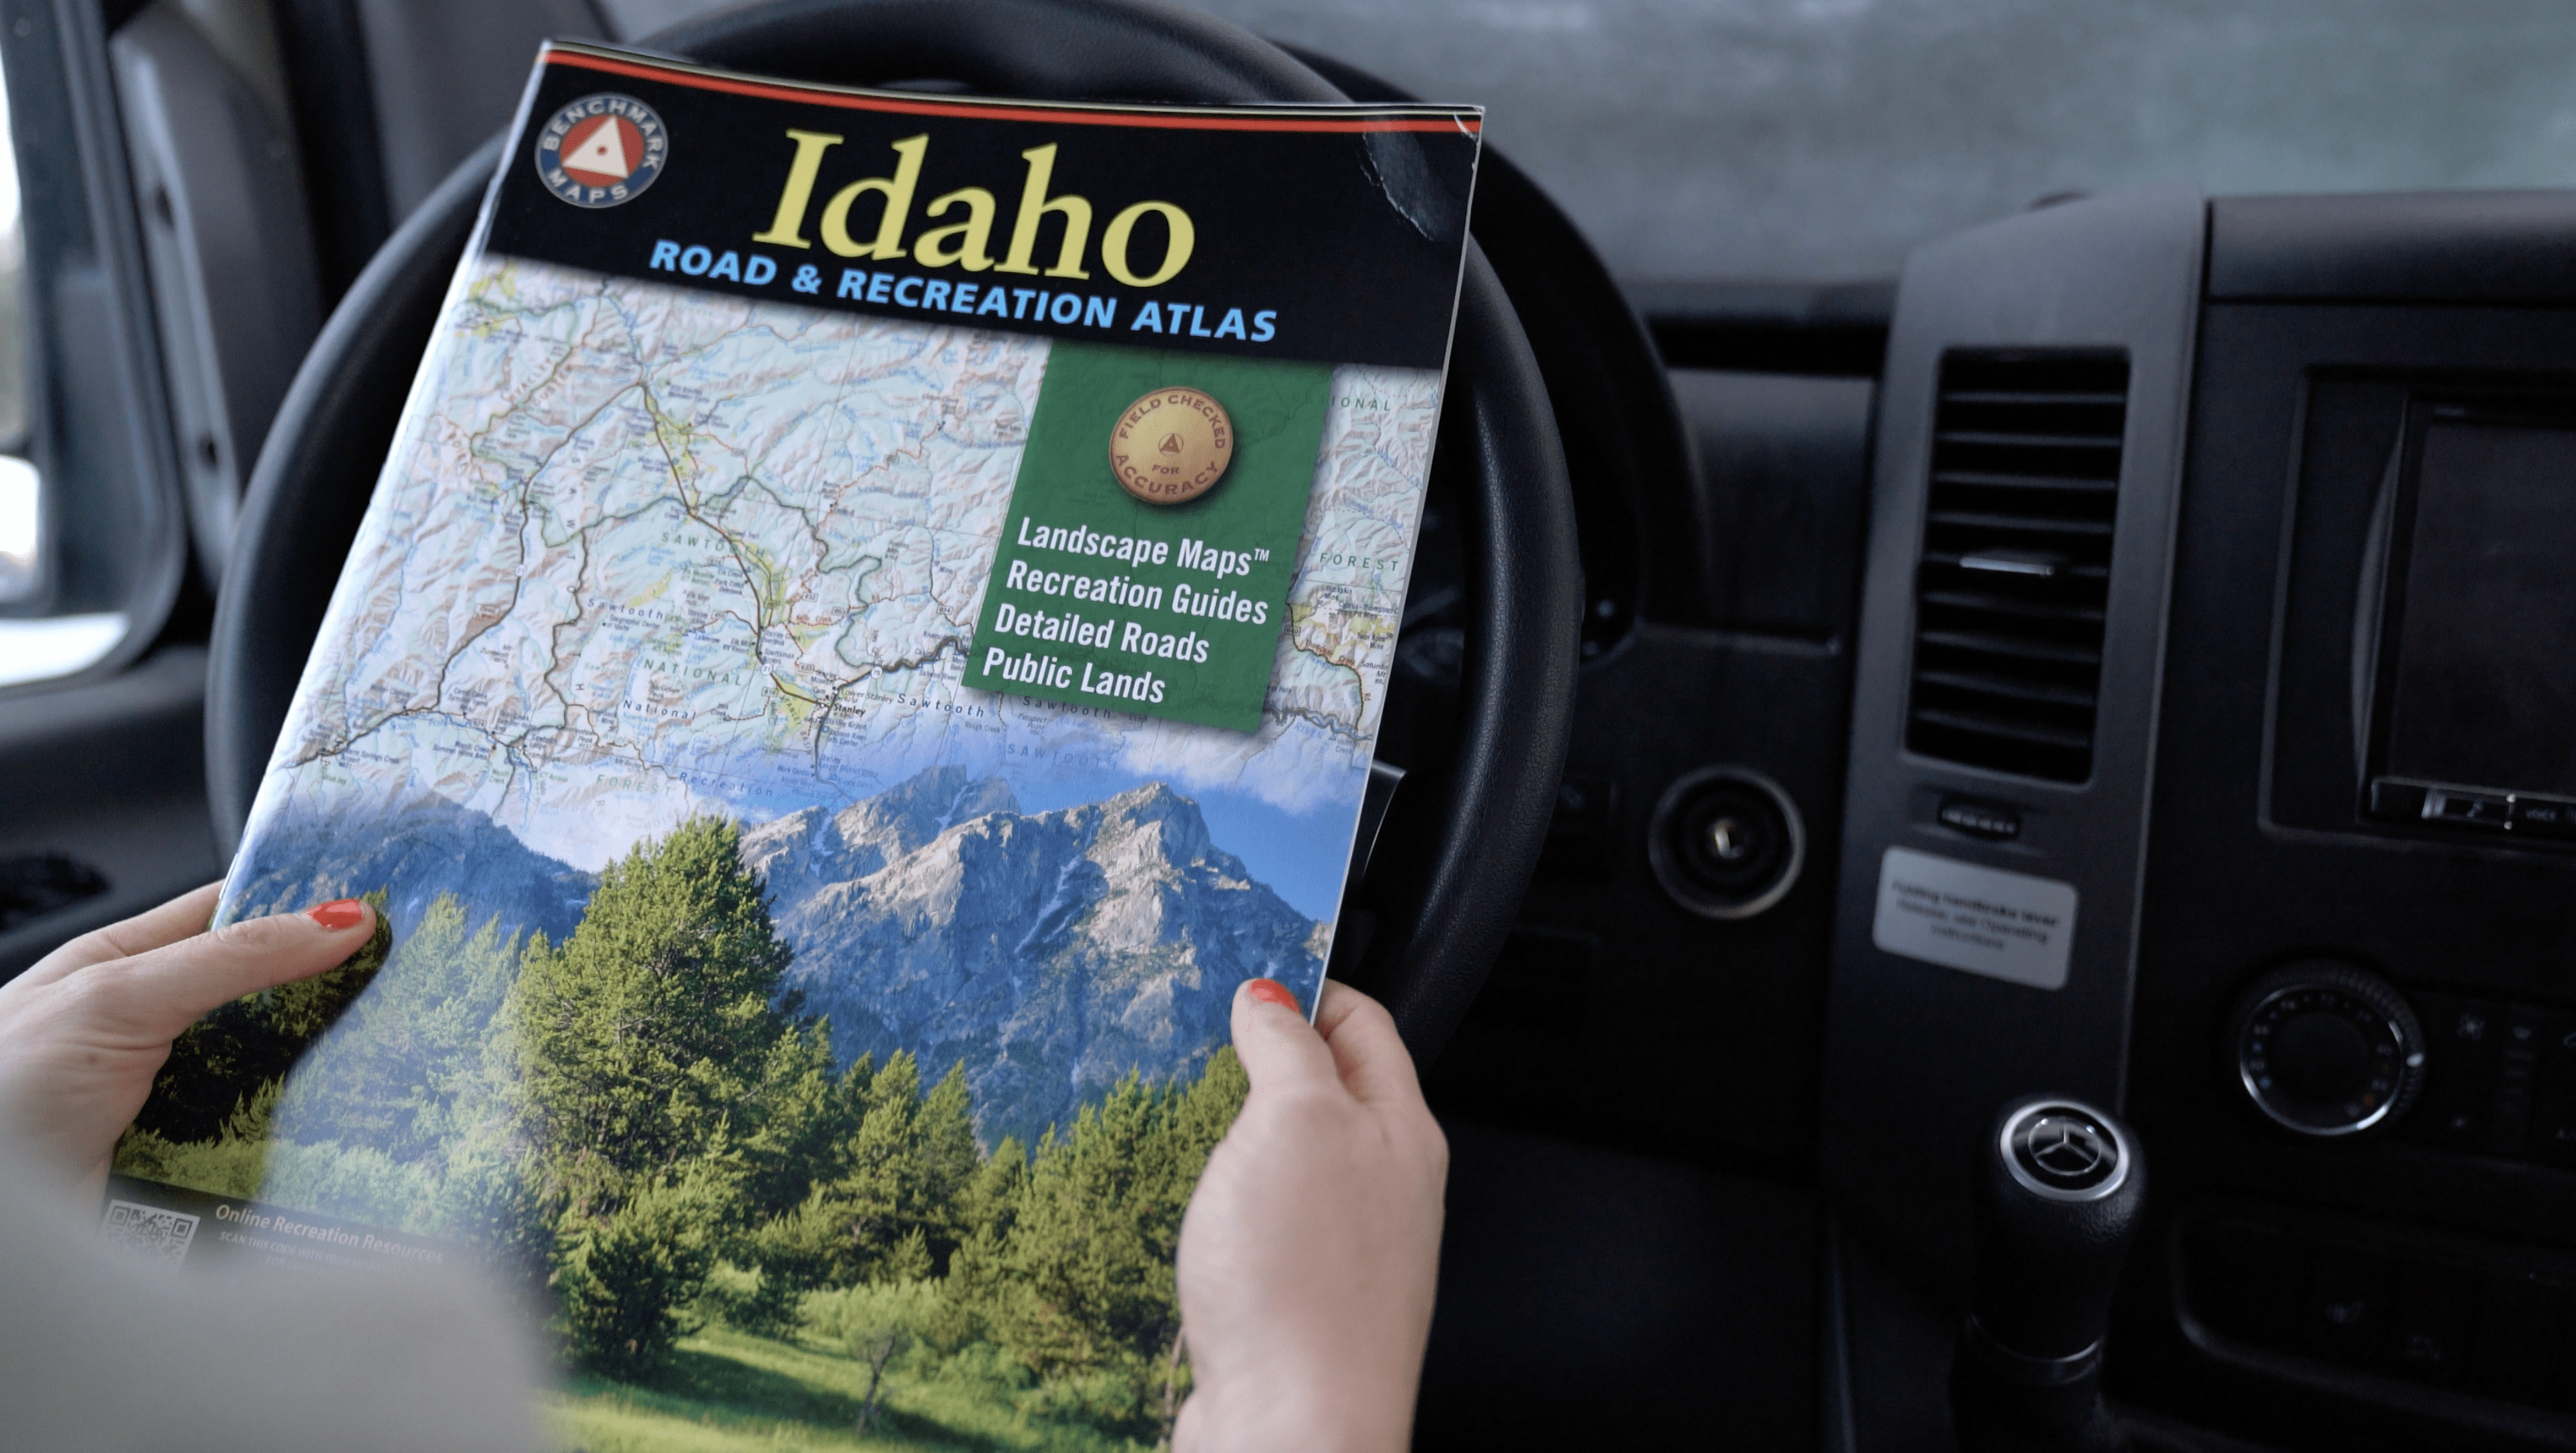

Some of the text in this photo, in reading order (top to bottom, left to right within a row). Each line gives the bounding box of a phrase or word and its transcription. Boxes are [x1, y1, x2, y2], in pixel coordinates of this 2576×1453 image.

[543, 99, 662, 170] BENCHMARK
[548, 169, 628, 204] MAPS
[753, 129, 1195, 287] Idaho
[649, 240, 1278, 343] ROAD & RECREATION ATLAS
[1119, 394, 1226, 449] FIELD CHECKED
[1116, 453, 1220, 496] ACCURACY
[1151, 464, 1180, 475] FOR
[1018, 516, 1168, 568] Landscape
[1319, 552, 1398, 572] FOREST
[1007, 559, 1269, 625] Recreation Guides
[587, 598, 663, 620] Sawtooth
[994, 602, 1210, 664] Detailed Roads
[643, 659, 742, 686] NATIONAL
[982, 646, 1166, 704] Public Lands
[623, 699, 697, 720] National
[834, 703, 866, 716] Stanley
[841, 688, 865, 698] Lower
[867, 692, 894, 705] Stanley
[897, 693, 984, 717] Sawtooth
[1022, 695, 1111, 720] Sawtooth
[596, 774, 673, 797] FOREST
[679, 772, 773, 798] Recreation
[216, 1204, 270, 1230] Online
[273, 1215, 359, 1248] Recreation
[219, 1231, 246, 1245] SCAN
